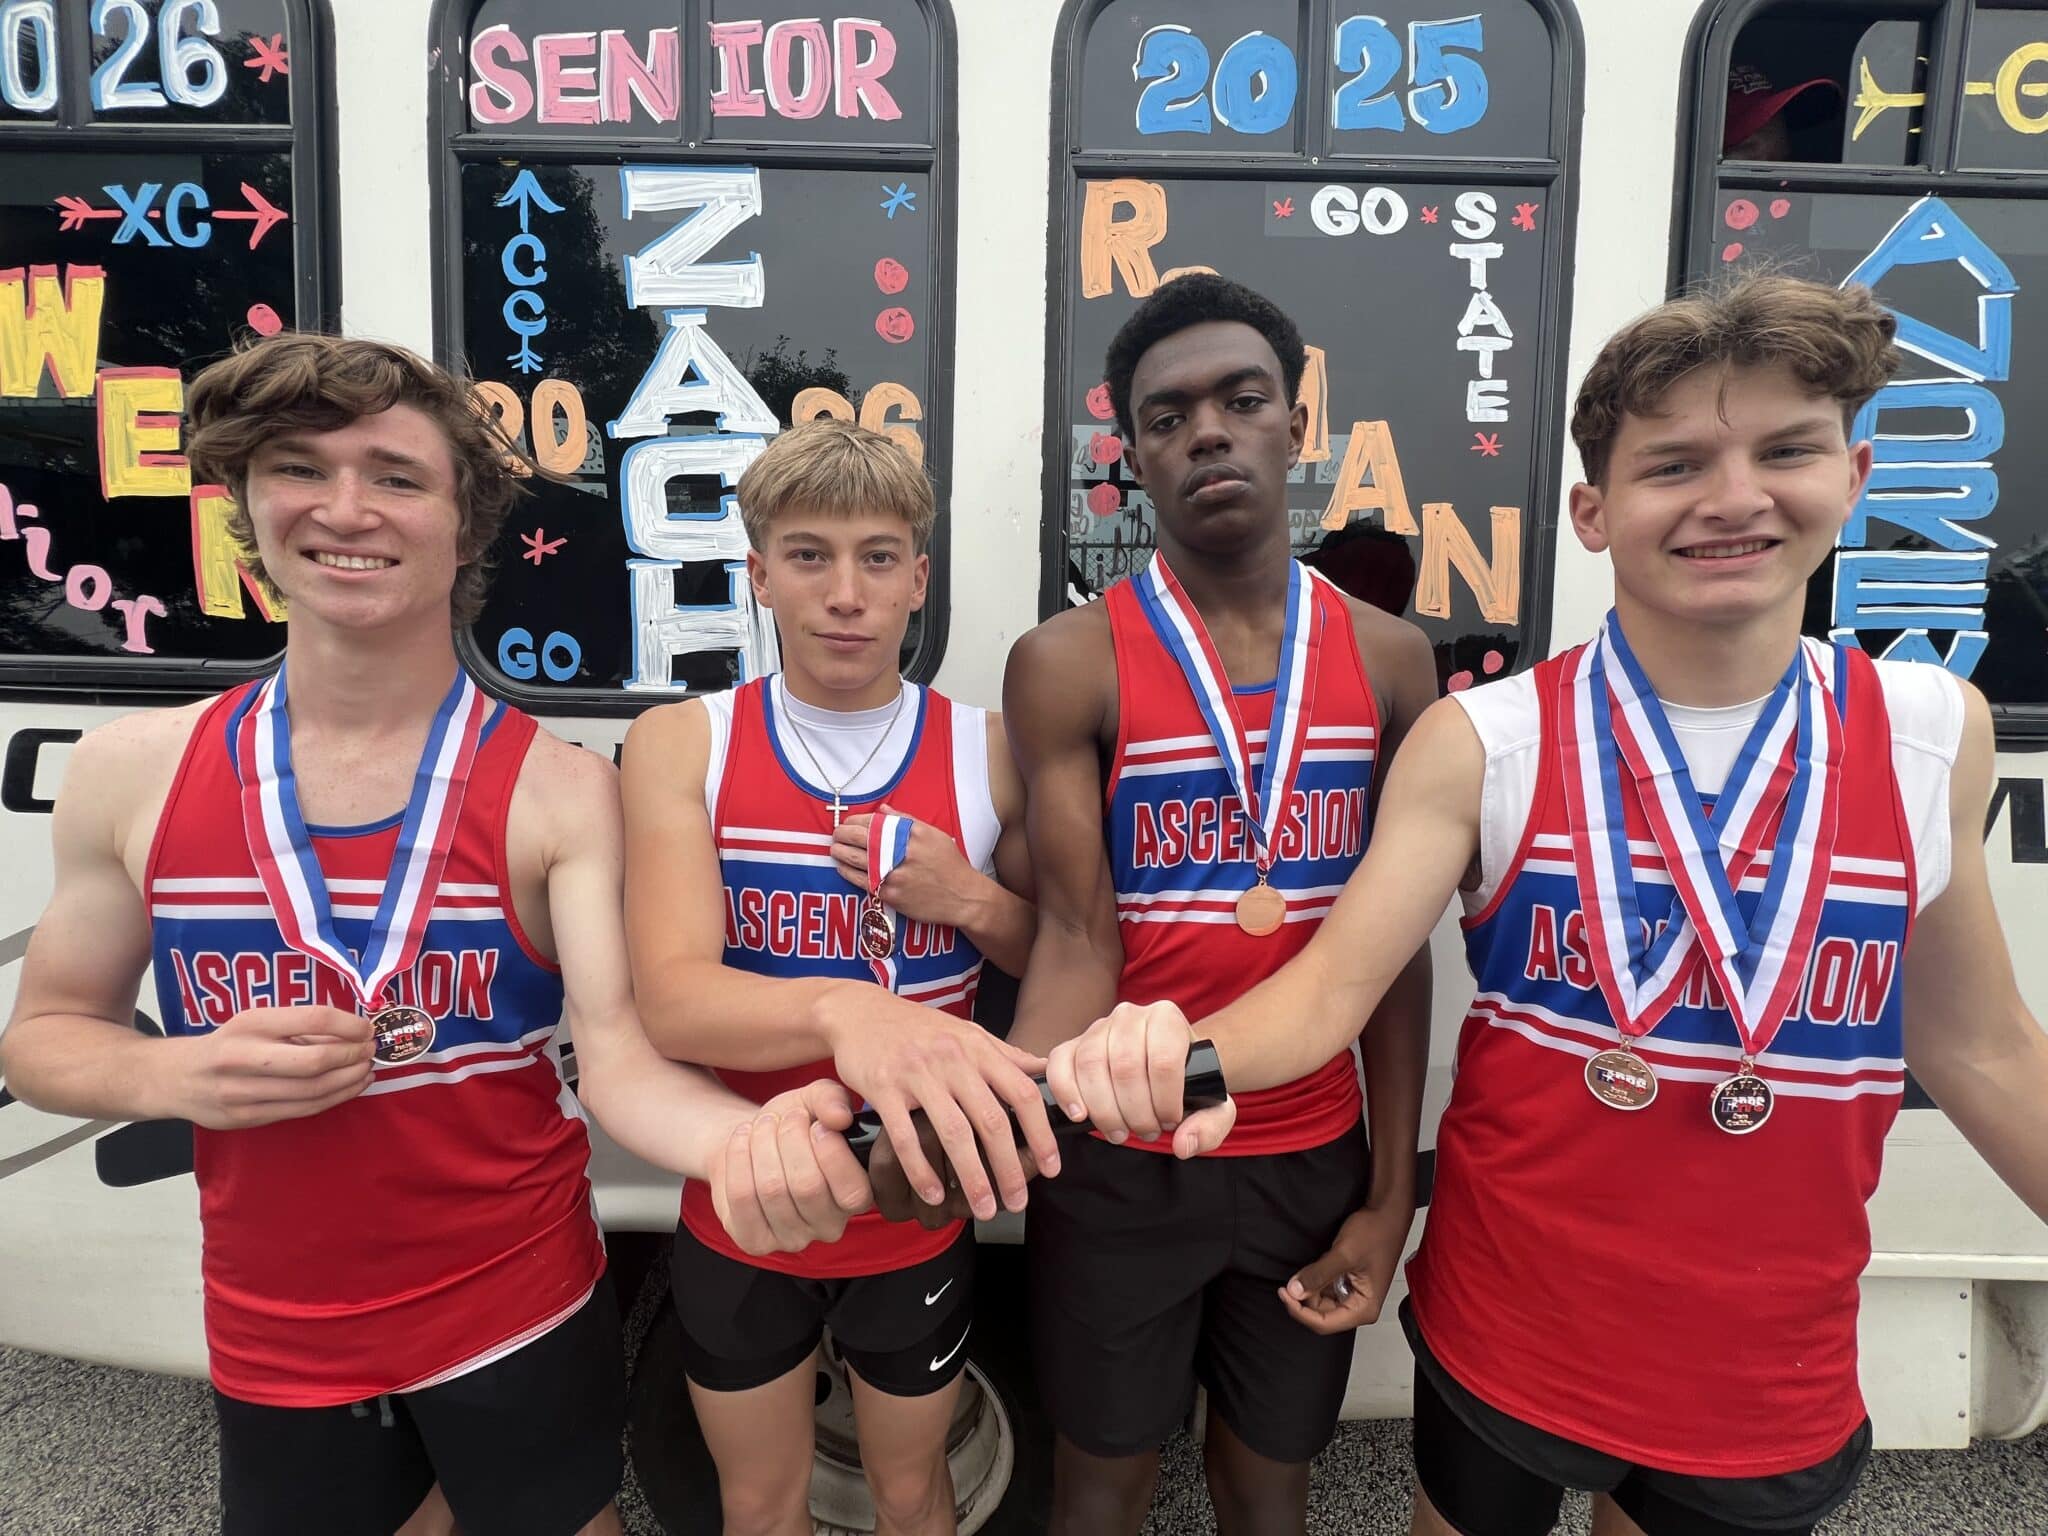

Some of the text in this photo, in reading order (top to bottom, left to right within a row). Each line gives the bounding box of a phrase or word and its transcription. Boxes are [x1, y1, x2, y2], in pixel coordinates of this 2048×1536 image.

[469, 18, 903, 124] SENIOR
[1133, 14, 1489, 134] 2025
[102, 182, 212, 248] XC
[1310, 184, 1409, 236] GO
[501, 233, 547, 336] CC
[1450, 191, 1514, 422] STATE
[606, 164, 783, 693] ZACH
[1081, 178, 1521, 625] RAN
[497, 627, 582, 682] GO
[1132, 787, 1366, 869] ASCESION
[722, 886, 957, 960] ASCENON
[170, 948, 499, 1027] ASCENION
